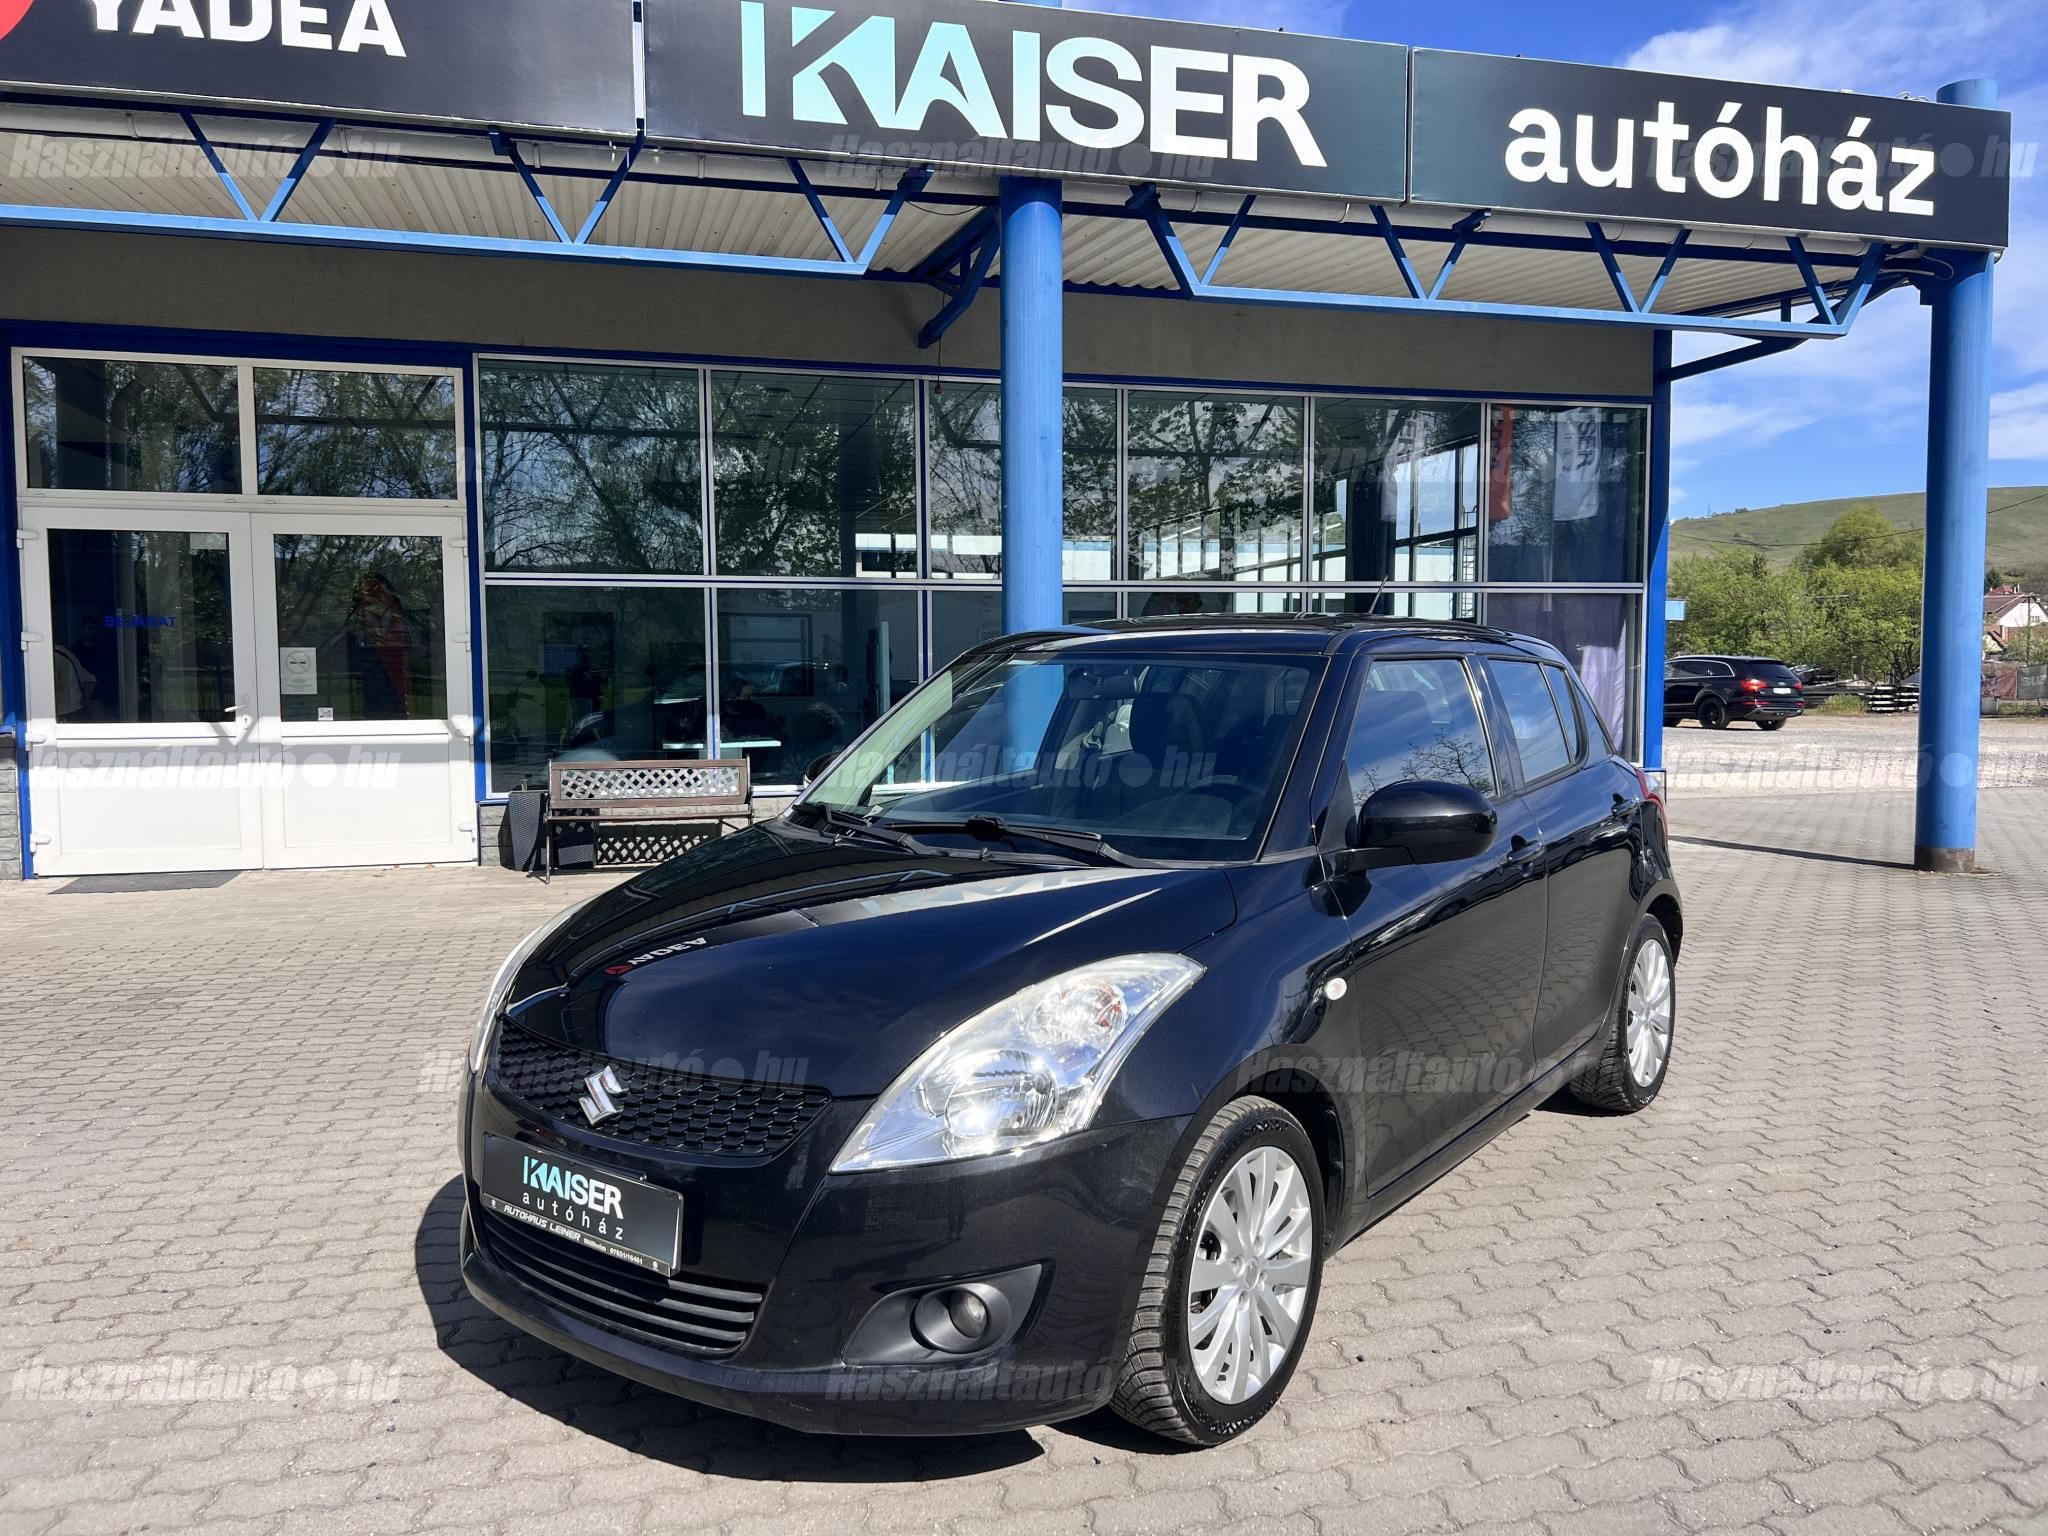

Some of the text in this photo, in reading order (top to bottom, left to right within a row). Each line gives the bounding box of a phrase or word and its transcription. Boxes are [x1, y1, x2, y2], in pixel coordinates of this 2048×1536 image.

[741, 0, 1327, 168] KAISER
[1505, 101, 1936, 217] autóház
[503, 1203, 548, 1229] AUTOHAUS
[549, 1221, 581, 1242] LEINER
[522, 1155, 625, 1220] KAISER
